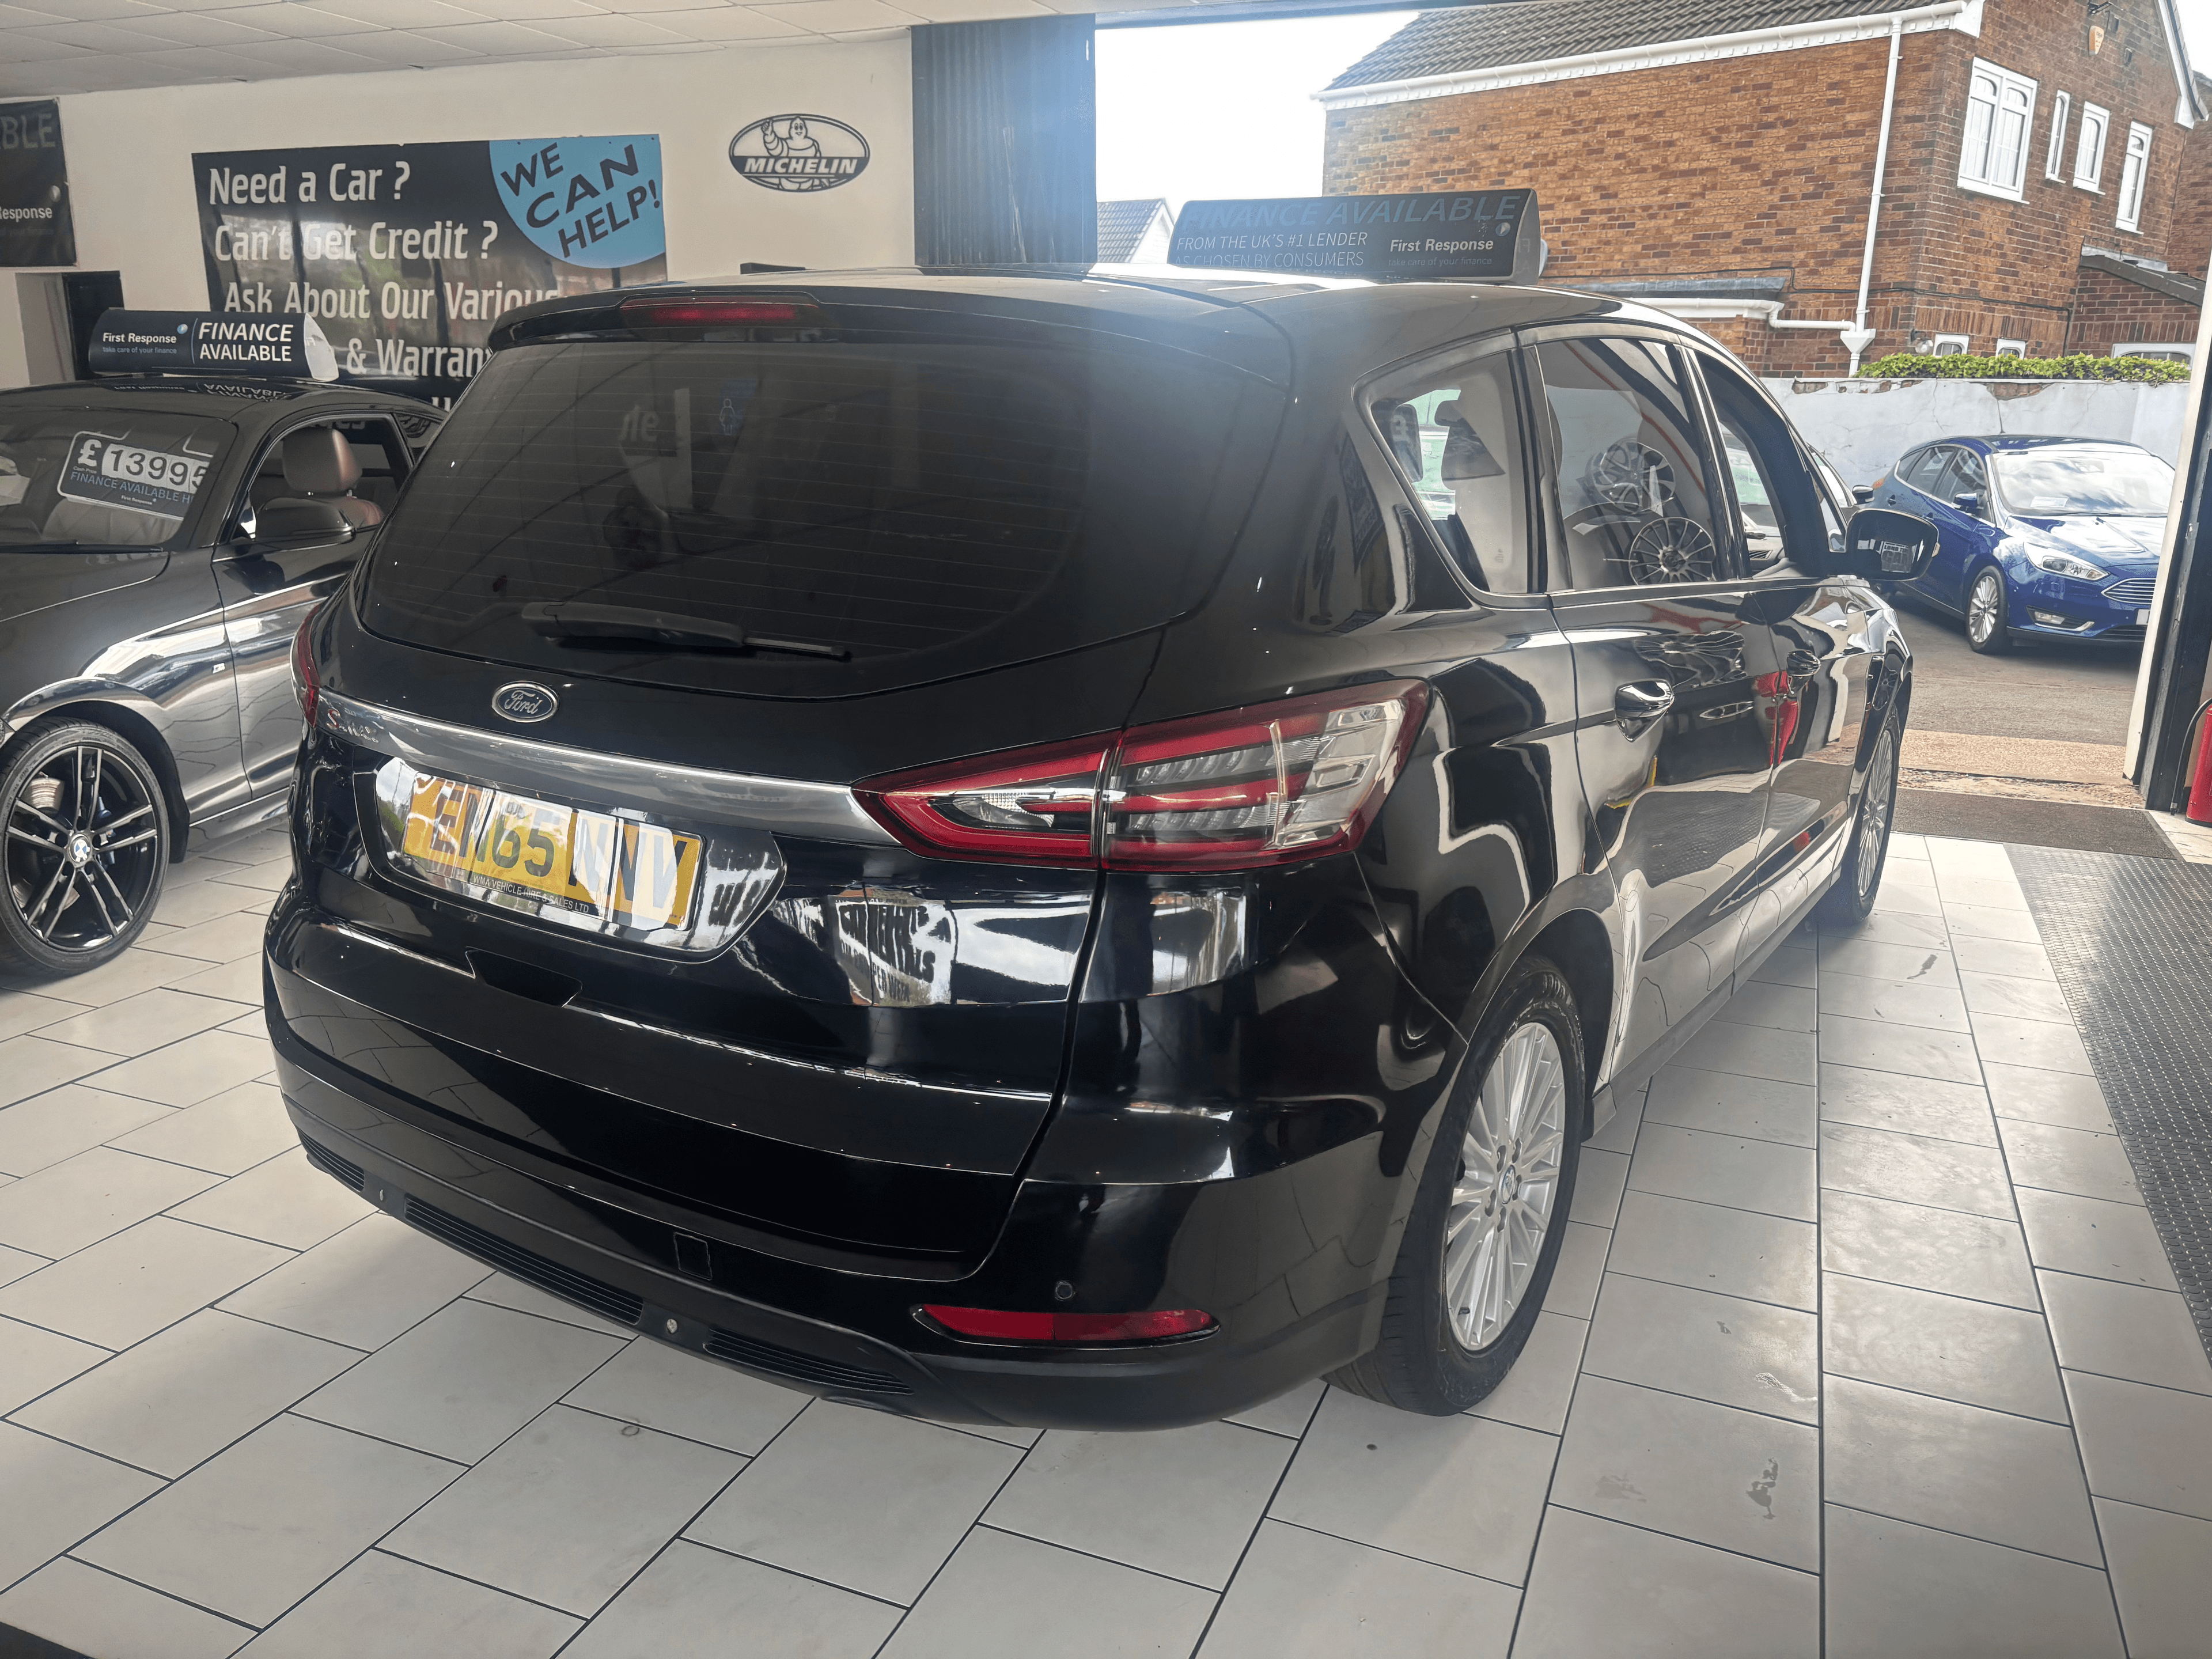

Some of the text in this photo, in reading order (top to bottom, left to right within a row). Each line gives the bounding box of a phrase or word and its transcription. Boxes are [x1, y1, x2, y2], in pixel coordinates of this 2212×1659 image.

[0, 114, 56, 149] BLE
[500, 142, 564, 196] WE
[744, 158, 858, 173] MICHELIN
[209, 161, 411, 205] Need a Car ?
[525, 143, 639, 228] CAN
[557, 179, 661, 259] HELP!
[1183, 195, 1521, 230] FINANCE AVAILABLE
[214, 221, 499, 262] Can't Get Credit ?
[1177, 237, 1215, 250] FROM
[1221, 236, 1248, 248] THE
[1287, 234, 1303, 247] #1
[1308, 232, 1368, 247] LENDER
[1390, 238, 1494, 254] First Response
[1194, 255, 1250, 267] CHOSEN
[1254, 253, 1271, 267] BY
[1274, 252, 1364, 267] CONSUMERS
[1389, 258, 1406, 266] take
[1438, 259, 1459, 268] your
[1461, 257, 1492, 265] finance
[224, 281, 560, 321] Ask About Our Vario
[103, 332, 176, 344] First Response
[199, 323, 293, 342] FINANCE
[154, 346, 177, 354] finance
[200, 344, 292, 362] AVAILABLE
[346, 339, 493, 378] & Warran
[70, 471, 118, 489] FINANCE
[119, 481, 179, 502] AVAILABLE
[504, 690, 543, 714] Ford
[473, 875, 490, 887] WMA
[491, 880, 522, 896] VEHICLE
[550, 895, 573, 910] SALES
[574, 903, 589, 914] LTD
